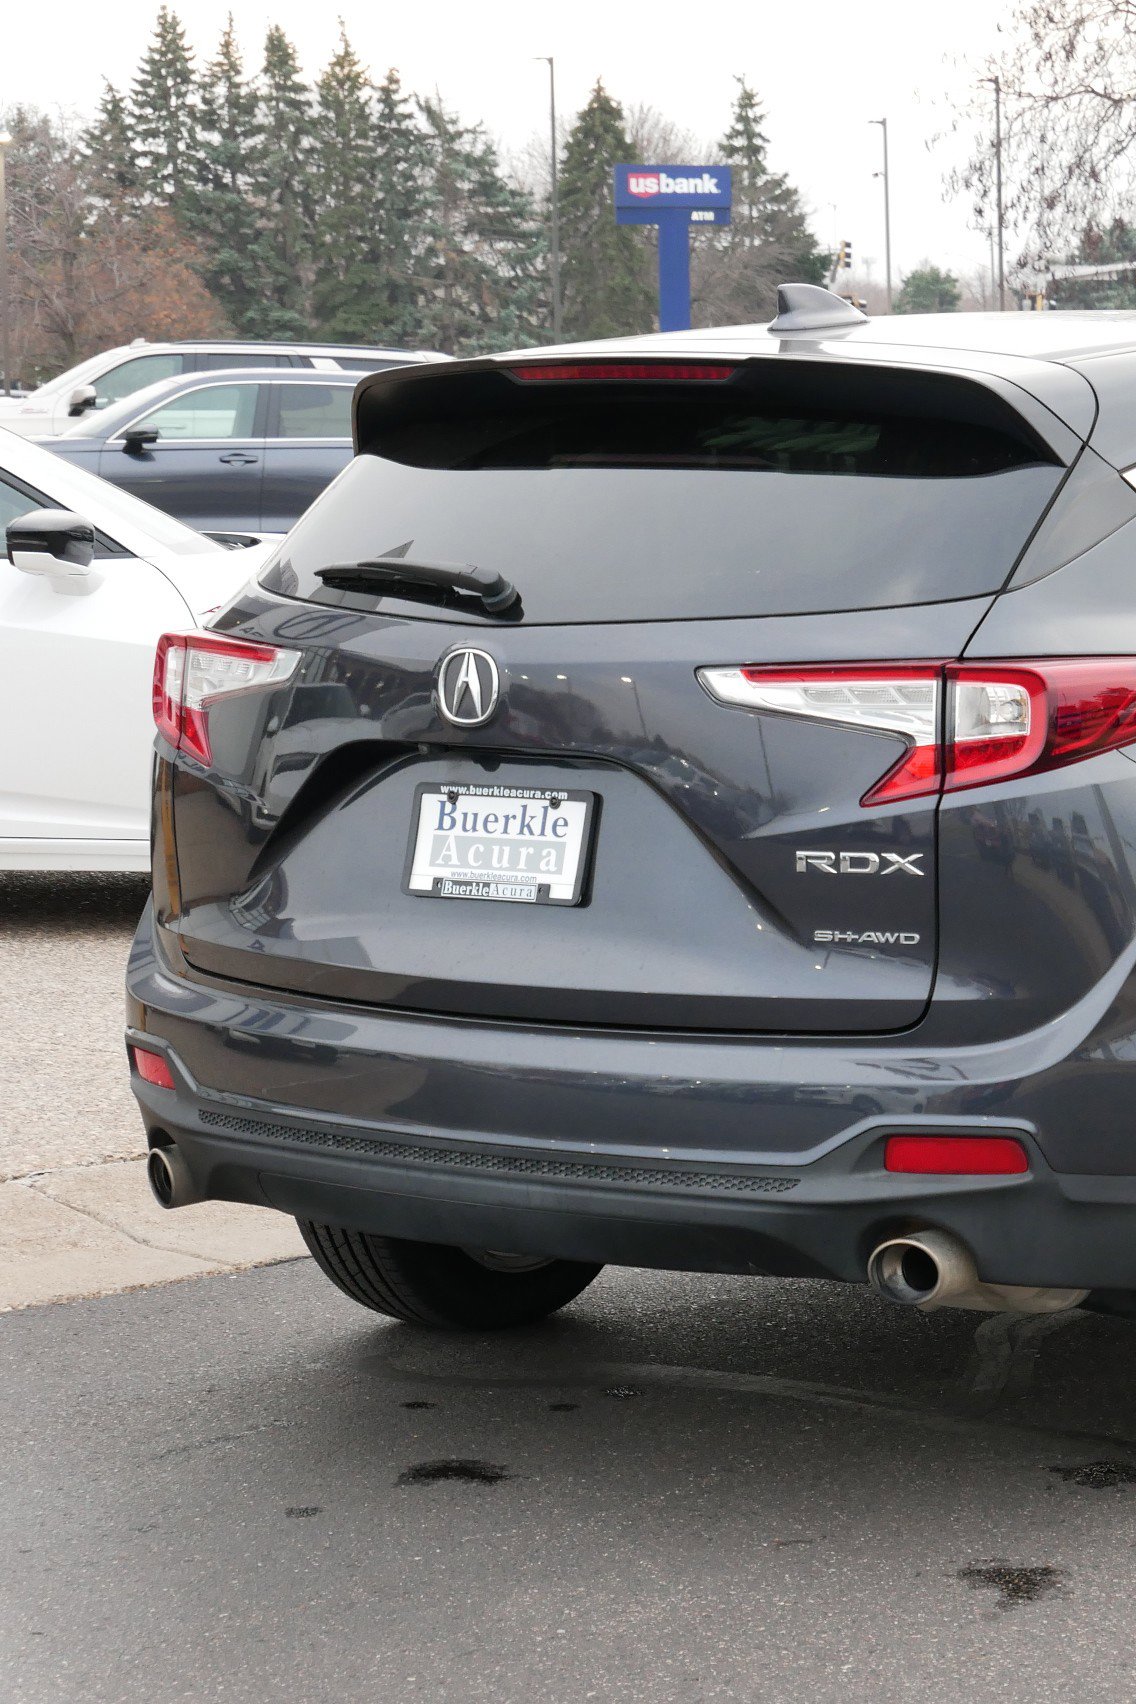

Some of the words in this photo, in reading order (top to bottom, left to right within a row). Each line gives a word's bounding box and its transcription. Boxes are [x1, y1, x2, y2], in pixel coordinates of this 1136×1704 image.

[691, 211, 715, 221] ATM
[441, 784, 568, 799] www.buerkleacura.com
[434, 800, 569, 838] Buerkle
[436, 834, 559, 872] Acura
[796, 850, 925, 876] RDX
[450, 871, 537, 882] www.buerkleacura.com
[814, 930, 920, 945] SH-AWD
